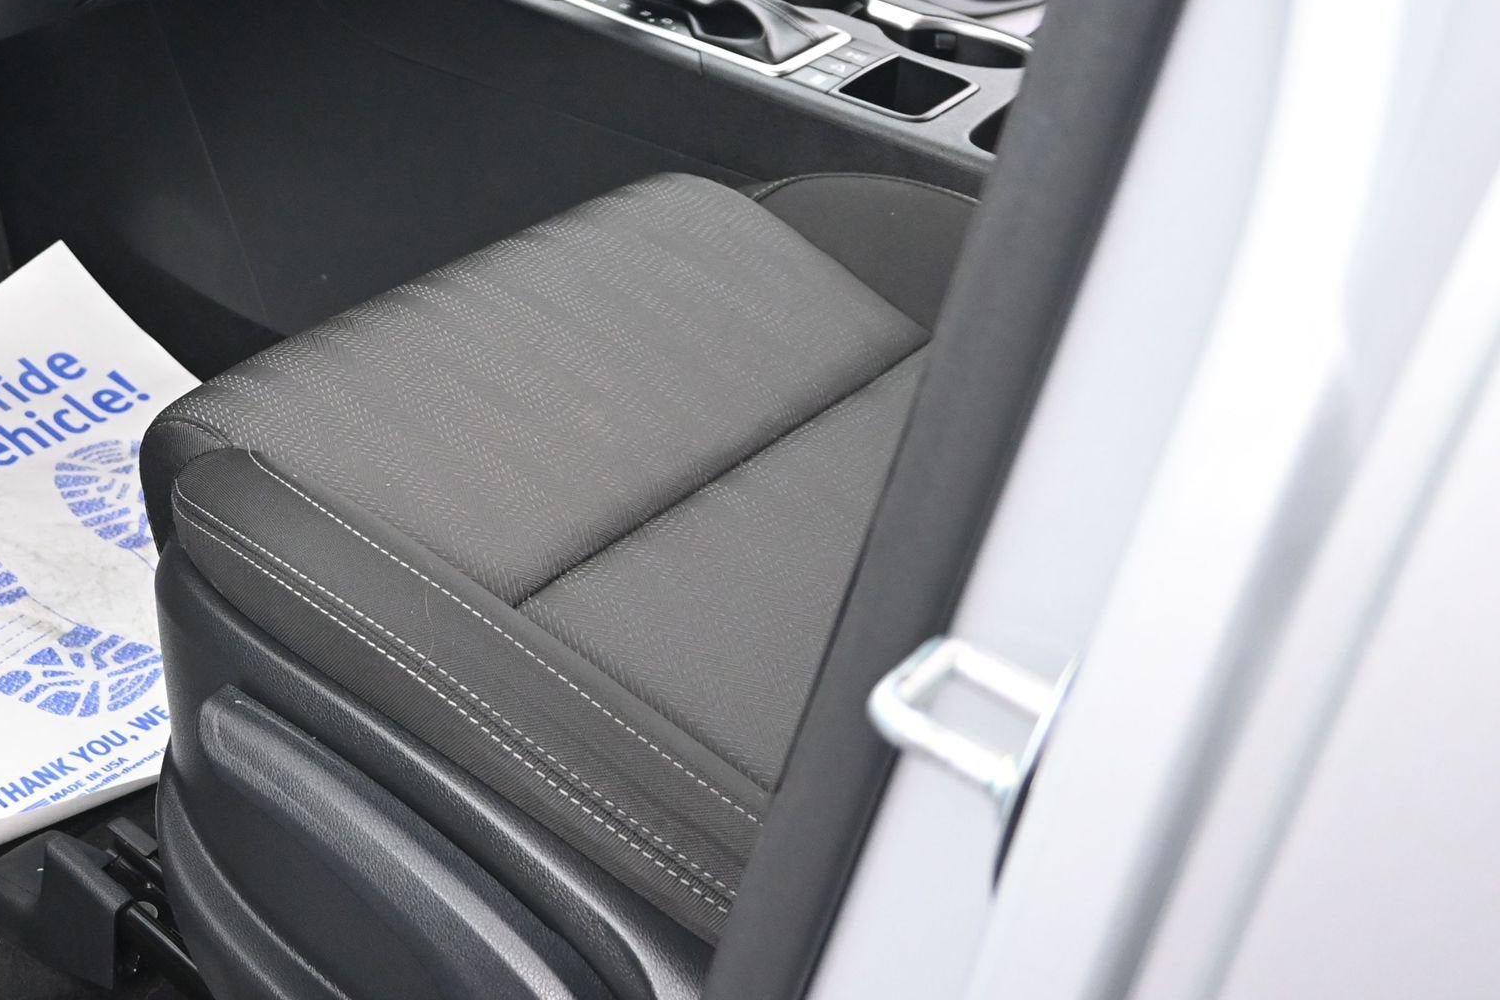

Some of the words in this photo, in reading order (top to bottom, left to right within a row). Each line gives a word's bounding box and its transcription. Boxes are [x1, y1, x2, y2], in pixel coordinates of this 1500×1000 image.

[68, 730, 140, 763] YOU,
[128, 705, 171, 731] WE
[50, 780, 87, 802] MADE
[86, 771, 100, 781] IN
[101, 756, 129, 772] USA
